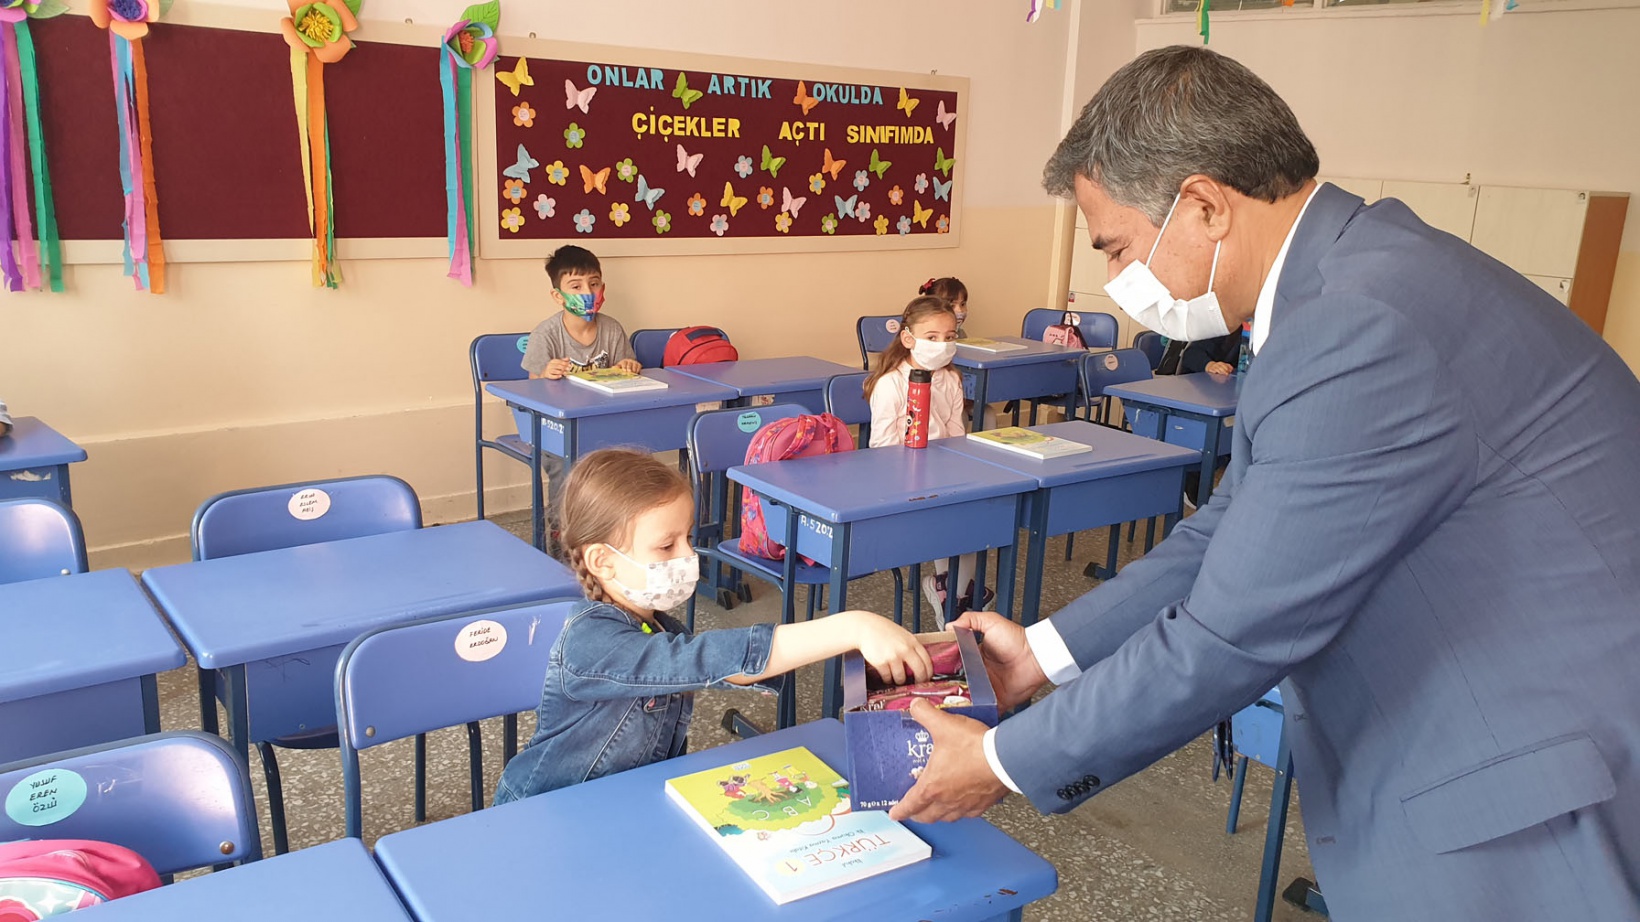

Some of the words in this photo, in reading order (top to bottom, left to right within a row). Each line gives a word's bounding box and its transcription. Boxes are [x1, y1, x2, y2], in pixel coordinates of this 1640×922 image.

[587, 65, 664, 90] ONLAR
[707, 74, 772, 99] ARTIK
[812, 82, 883, 105] OKULDA
[632, 106, 740, 142] ÇİÇEKLER
[778, 121, 825, 147] AÇTI
[846, 125, 934, 144] SINIFIMDA
[906, 739, 934, 758] kra
[30, 775, 57, 789] YUSUF
[29, 788, 58, 801] EREN
[797, 796, 811, 807] A
[752, 809, 770, 821] C
[782, 805, 798, 816] B
[804, 834, 891, 867] TÜRKÇE
[785, 861, 798, 872] 1
